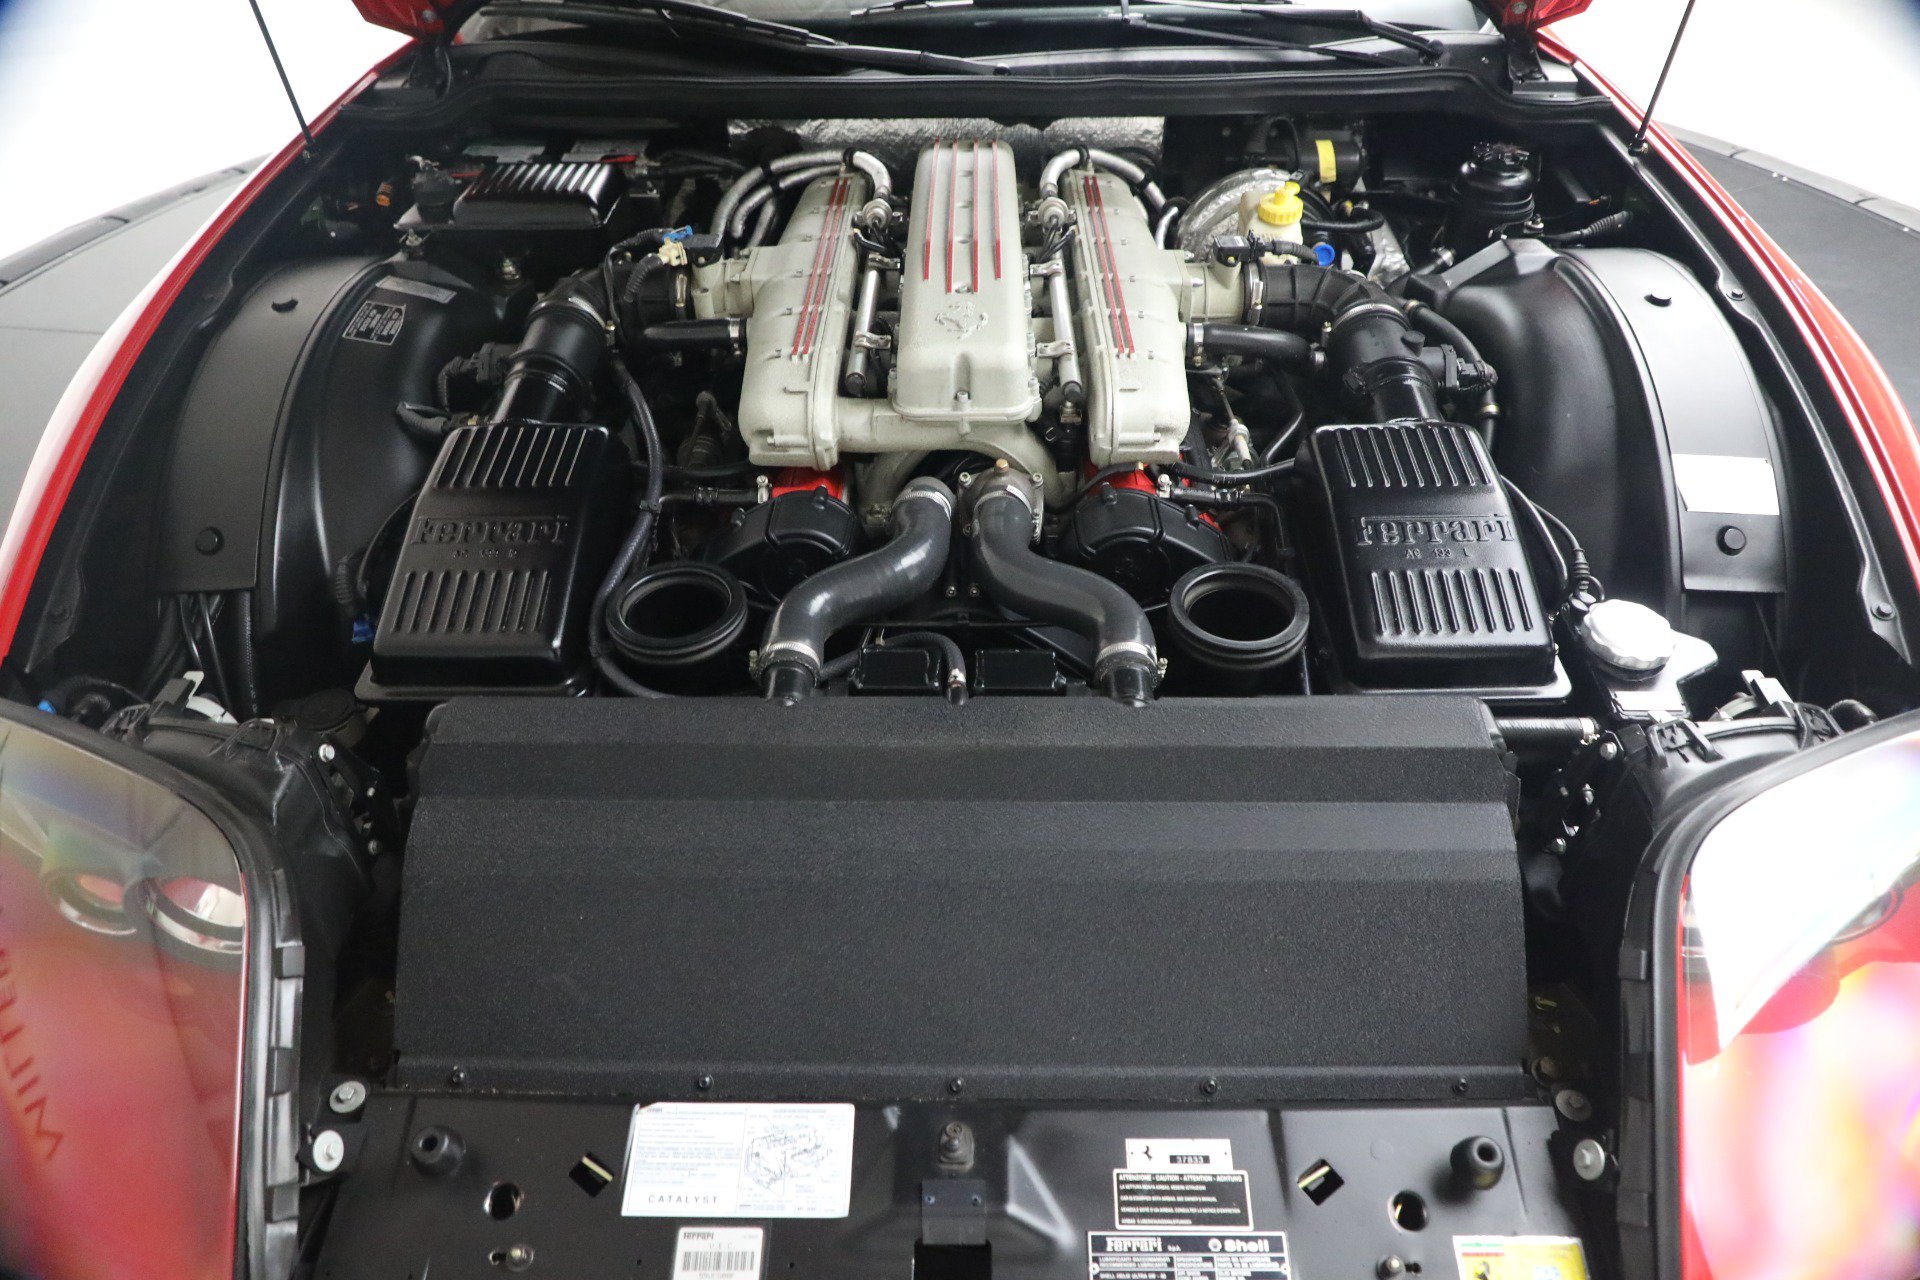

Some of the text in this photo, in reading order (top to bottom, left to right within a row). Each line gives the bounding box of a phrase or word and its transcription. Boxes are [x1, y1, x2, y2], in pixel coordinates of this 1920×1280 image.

[410, 515, 568, 545] Ferrari
[1354, 514, 1516, 546] Ferrari
[1155, 1174, 1180, 1182] CAUTION
[1183, 1174, 1213, 1182] ATTENTION
[648, 1195, 718, 1204] CATALYST
[683, 1232, 714, 1240] Ferrari
[1105, 1236, 1163, 1252] Ferrari
[1224, 1238, 1270, 1253] Shell
